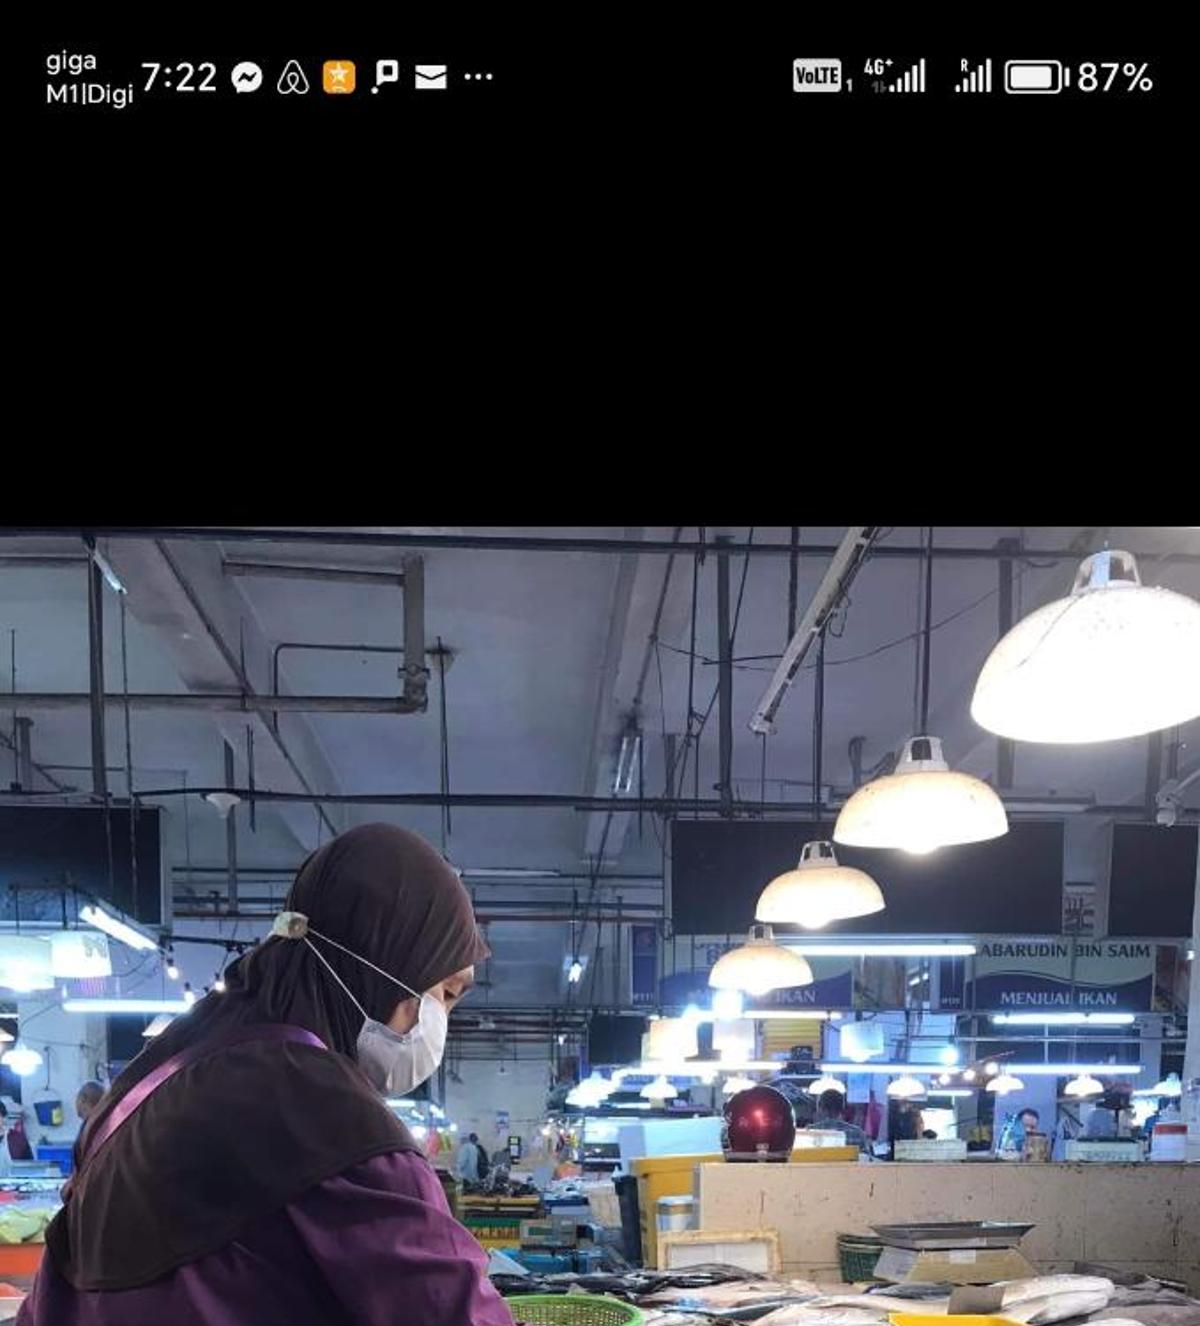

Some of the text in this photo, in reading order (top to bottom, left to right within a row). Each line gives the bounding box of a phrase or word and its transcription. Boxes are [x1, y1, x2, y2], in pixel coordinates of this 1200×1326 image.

[979, 943, 1150, 958] ABARUDIN BIN SAIM
[776, 989, 816, 1004] IKAN
[1079, 991, 1118, 1006] IKAN
